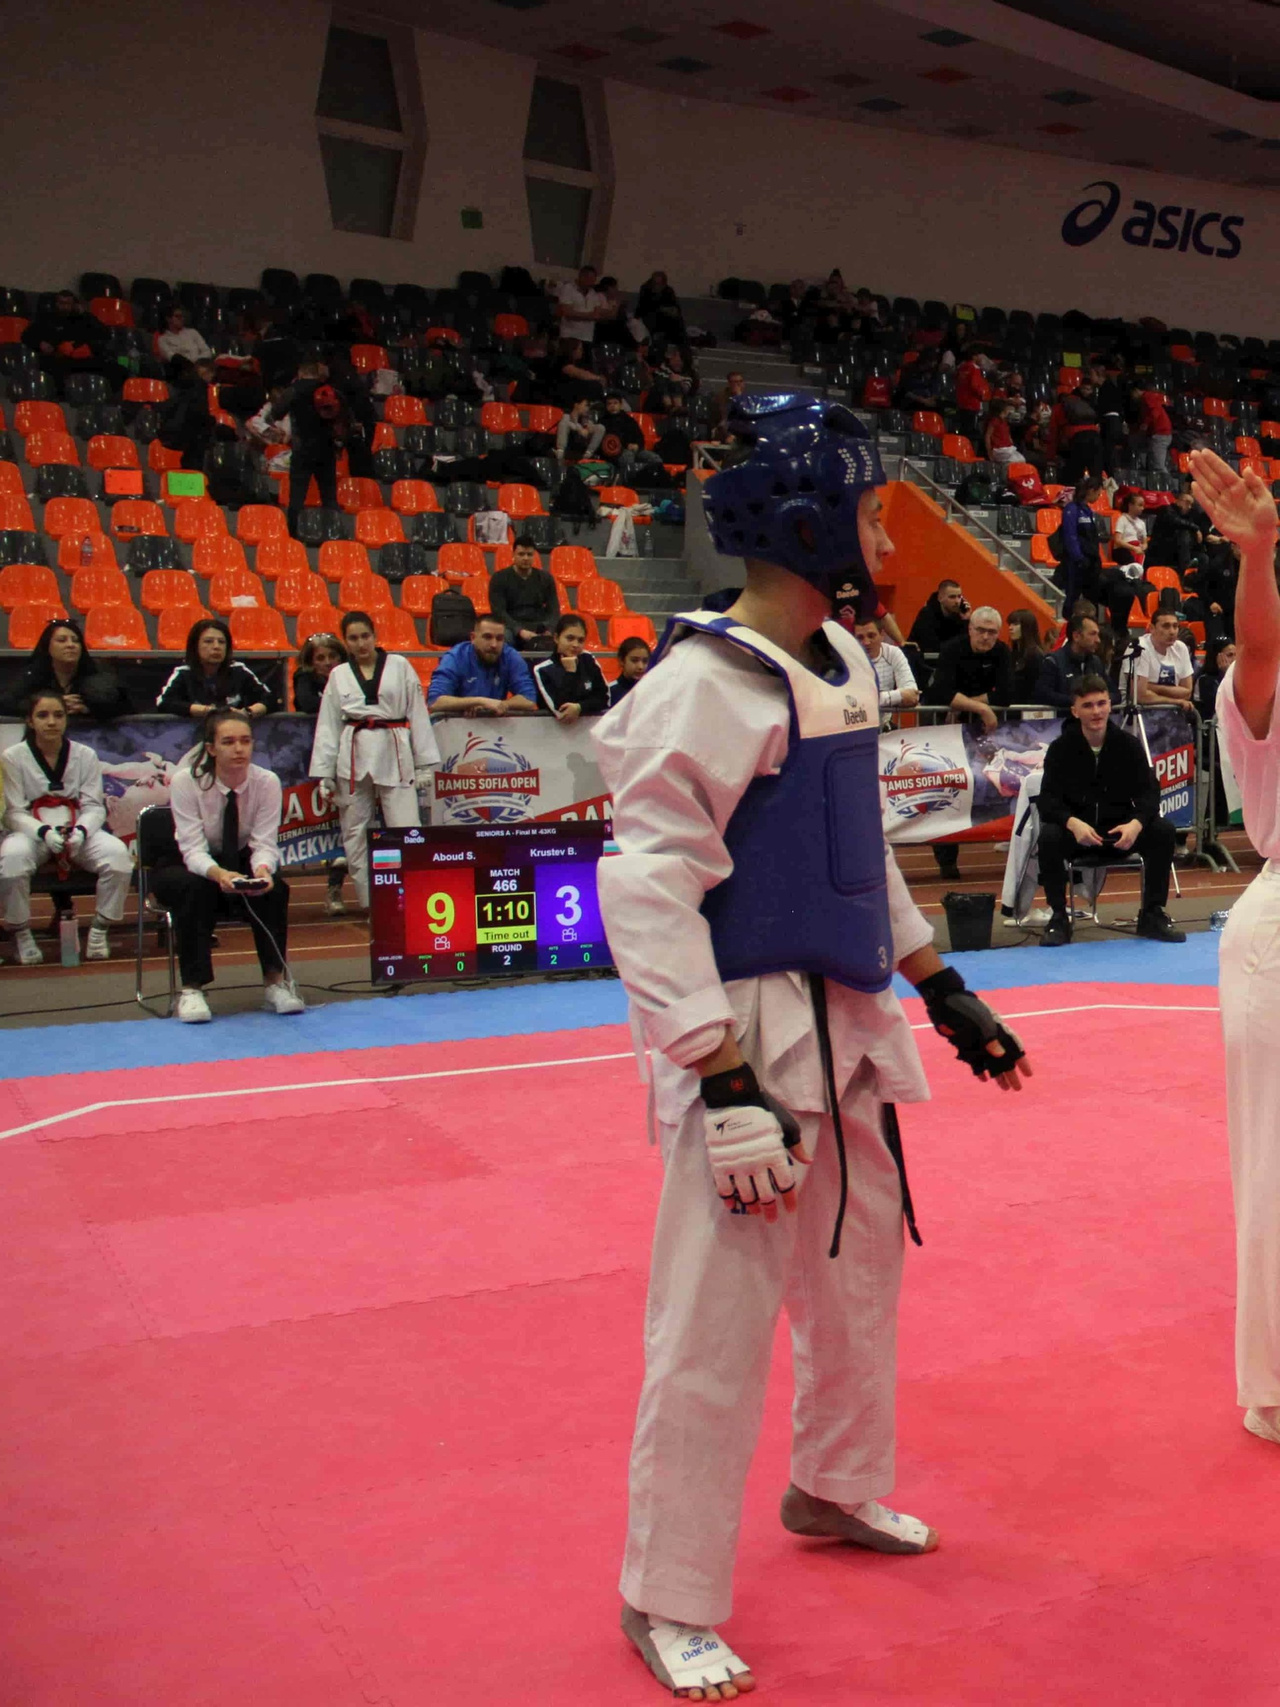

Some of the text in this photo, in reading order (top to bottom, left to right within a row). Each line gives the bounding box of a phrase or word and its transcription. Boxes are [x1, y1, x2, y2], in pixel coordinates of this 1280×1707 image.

[843, 706, 868, 725] Daedo
[1155, 749, 1188, 782] PEN
[437, 776, 537, 792] RAMUS SOFIA OPEN
[915, 774, 943, 788] SOFIA
[943, 773, 966, 785] OPEN
[476, 830, 505, 838] SENIORS
[433, 851, 476, 862] Aboud S.
[530, 847, 578, 858] Krustev B.
[490, 868, 521, 878] MATCH
[374, 874, 402, 886] BUL
[493, 879, 518, 892] 466
[482, 900, 530, 922] 1:10
[555, 885, 582, 927] 3
[426, 892, 456, 935] 9
[484, 930, 530, 941] Time out
[492, 943, 523, 953] ROUND
[503, 955, 512, 966] 2
[550, 954, 558, 965] 2
[583, 952, 590, 963] 0
[877, 946, 888, 969] 3
[387, 965, 395, 976] 0
[422, 963, 429, 974] 1
[456, 961, 464, 972] 0
